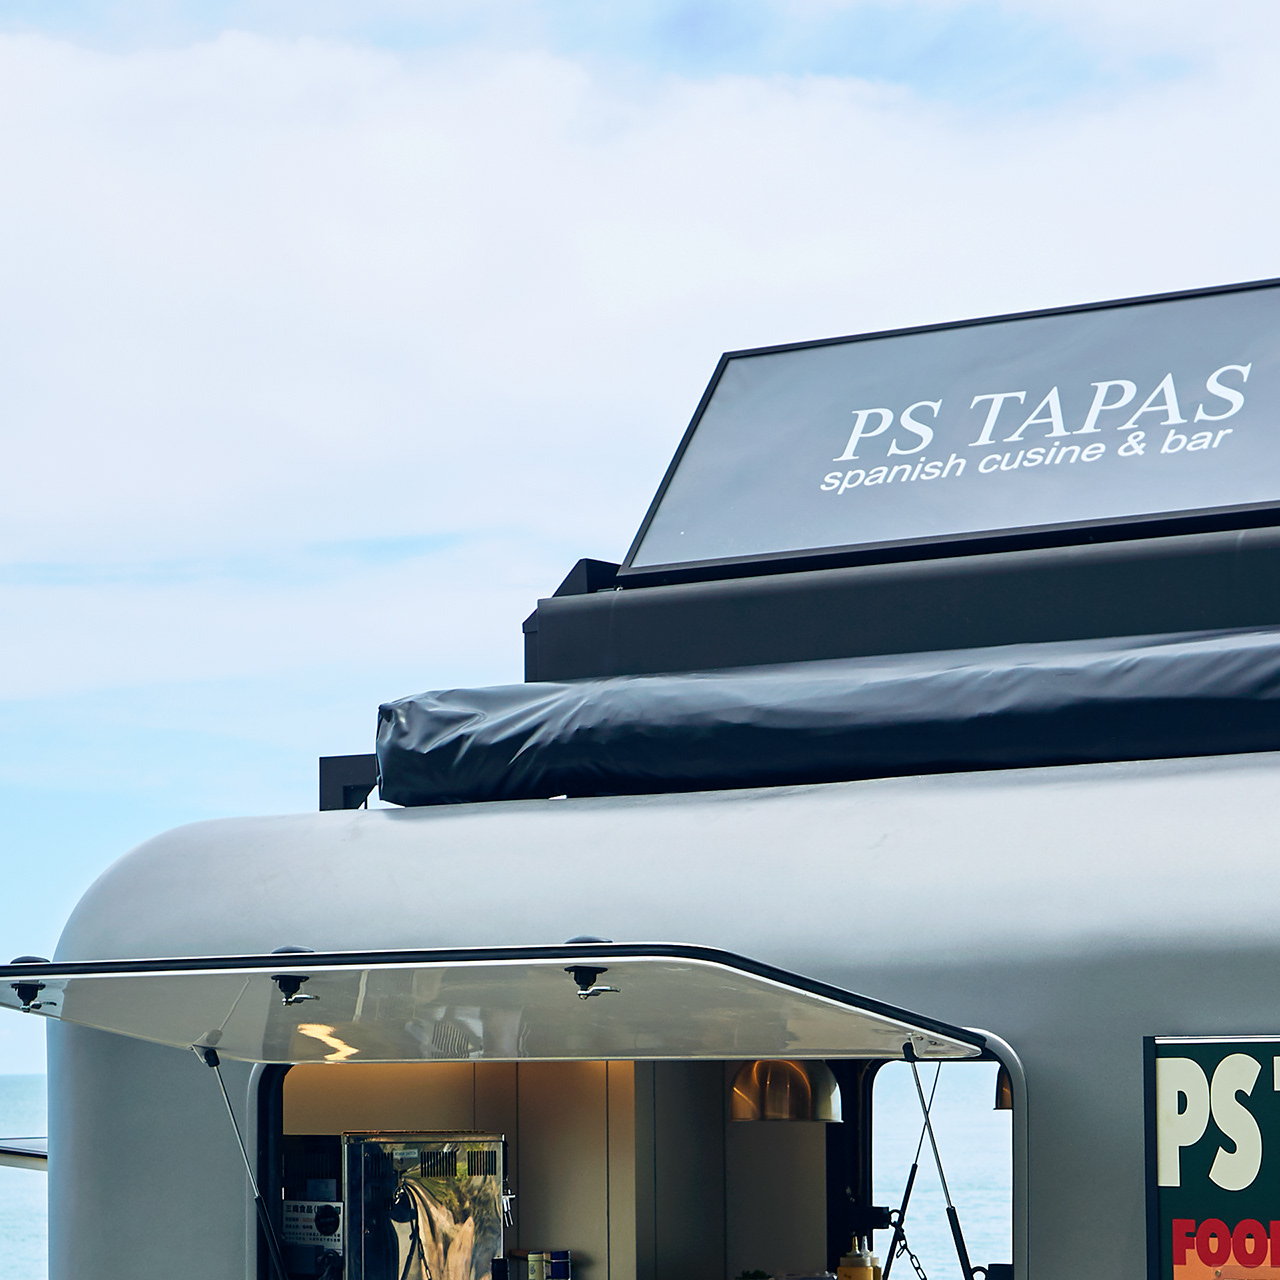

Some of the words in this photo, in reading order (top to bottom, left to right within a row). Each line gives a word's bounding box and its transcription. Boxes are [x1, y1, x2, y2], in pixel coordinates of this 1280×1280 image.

[820, 453, 967, 495] spanish
[978, 439, 1106, 474] cusine
[1117, 431, 1147, 457] &
[1160, 425, 1233, 454] bar
[833, 398, 943, 462] PS
[968, 362, 1252, 447] TAPAS
[1156, 1052, 1263, 1191] PS
